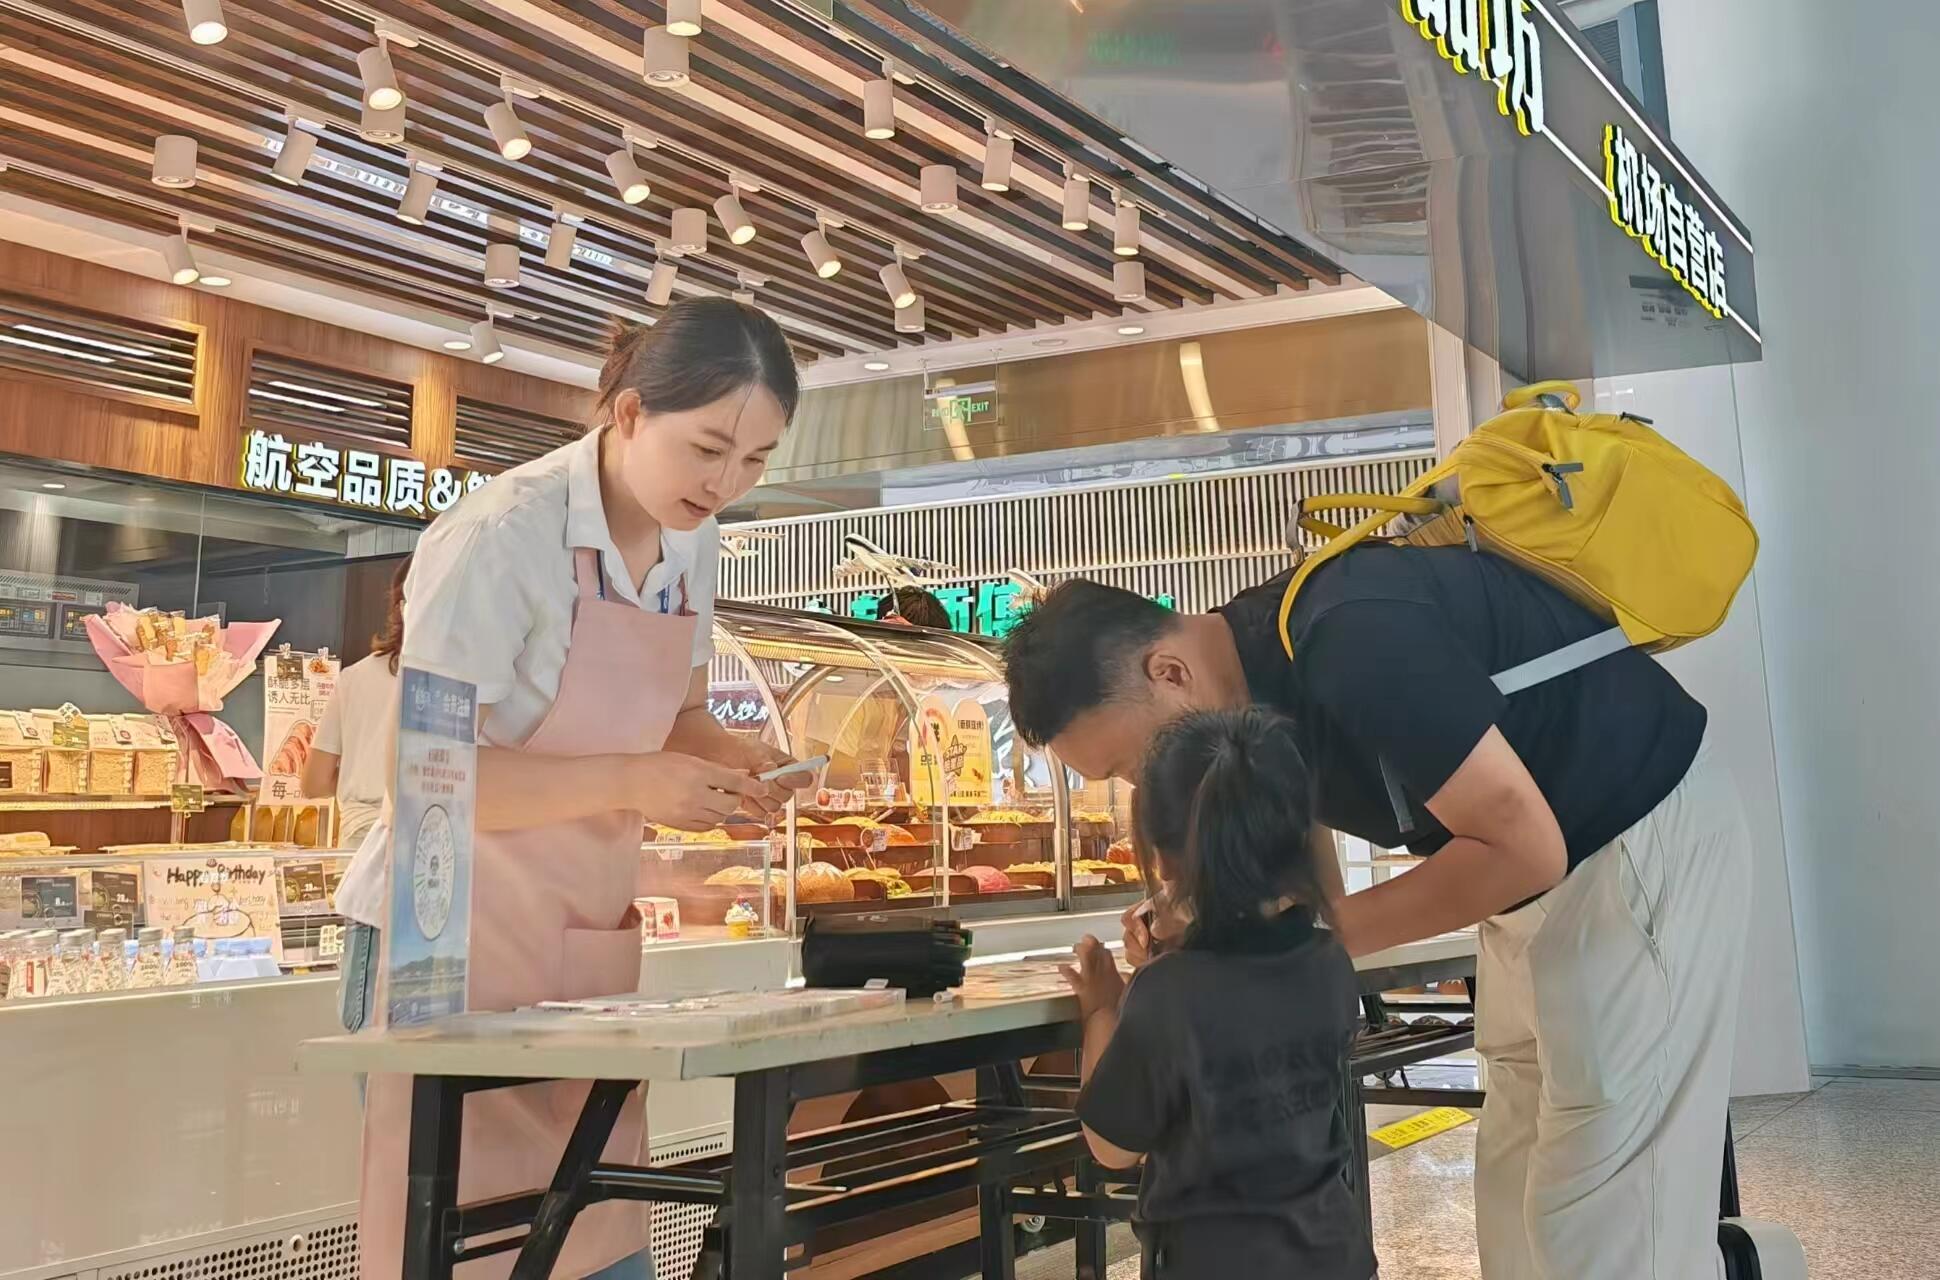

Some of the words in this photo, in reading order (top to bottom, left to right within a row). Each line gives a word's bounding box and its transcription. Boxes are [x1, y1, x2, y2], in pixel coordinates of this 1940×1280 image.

[1605, 124, 1729, 318] 机场自营店
[971, 401, 989, 413] EXIT
[245, 430, 495, 514] 航空品质&
[268, 691, 311, 705] 诱人无比
